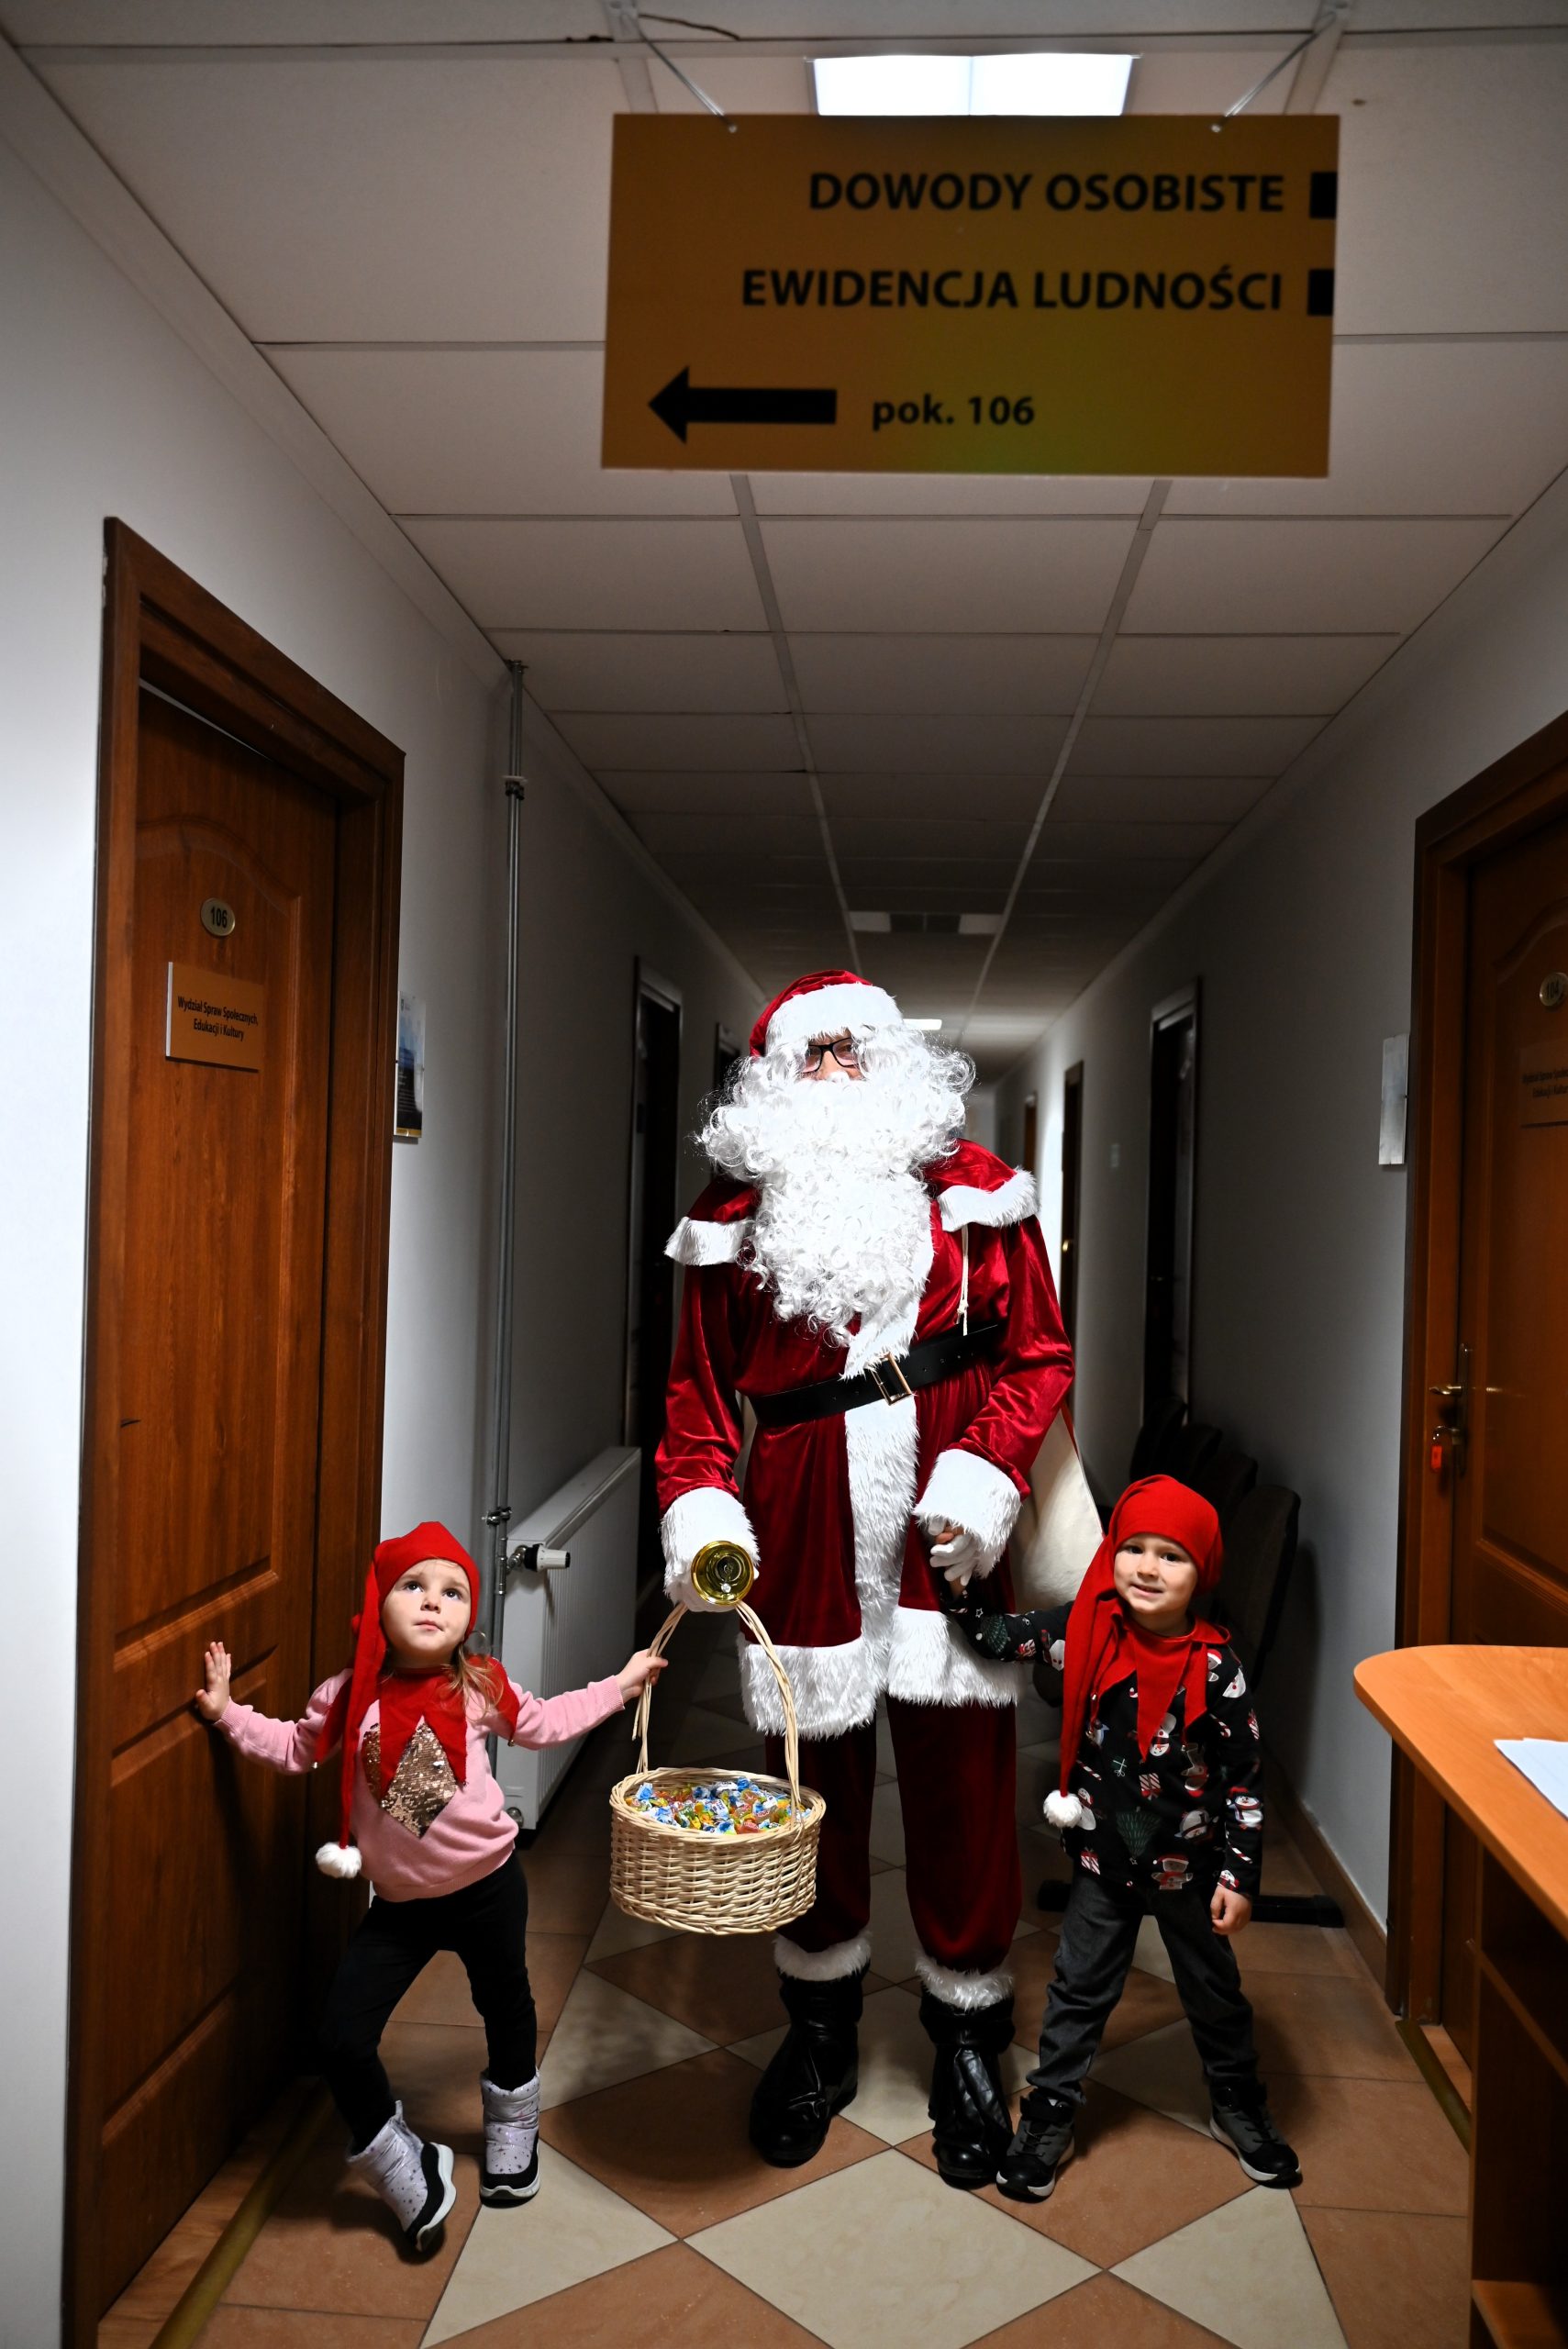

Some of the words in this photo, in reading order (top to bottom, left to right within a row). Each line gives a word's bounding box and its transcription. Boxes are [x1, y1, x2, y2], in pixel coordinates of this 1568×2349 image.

[810, 173, 1032, 211] DOWODY
[1046, 173, 1284, 212] OSOBISTE
[742, 269, 1018, 308] EWIDENCJA
[1034, 264, 1282, 310] LUDNOŚCI
[873, 393, 954, 432] pok.
[968, 395, 1035, 426] 106
[210, 907, 228, 929] 106
[177, 996, 203, 1013] Wydział
[204, 1001, 222, 1018] Spraw
[194, 1018, 219, 1037] Edukacji
[223, 1024, 244, 1042] Kultury
